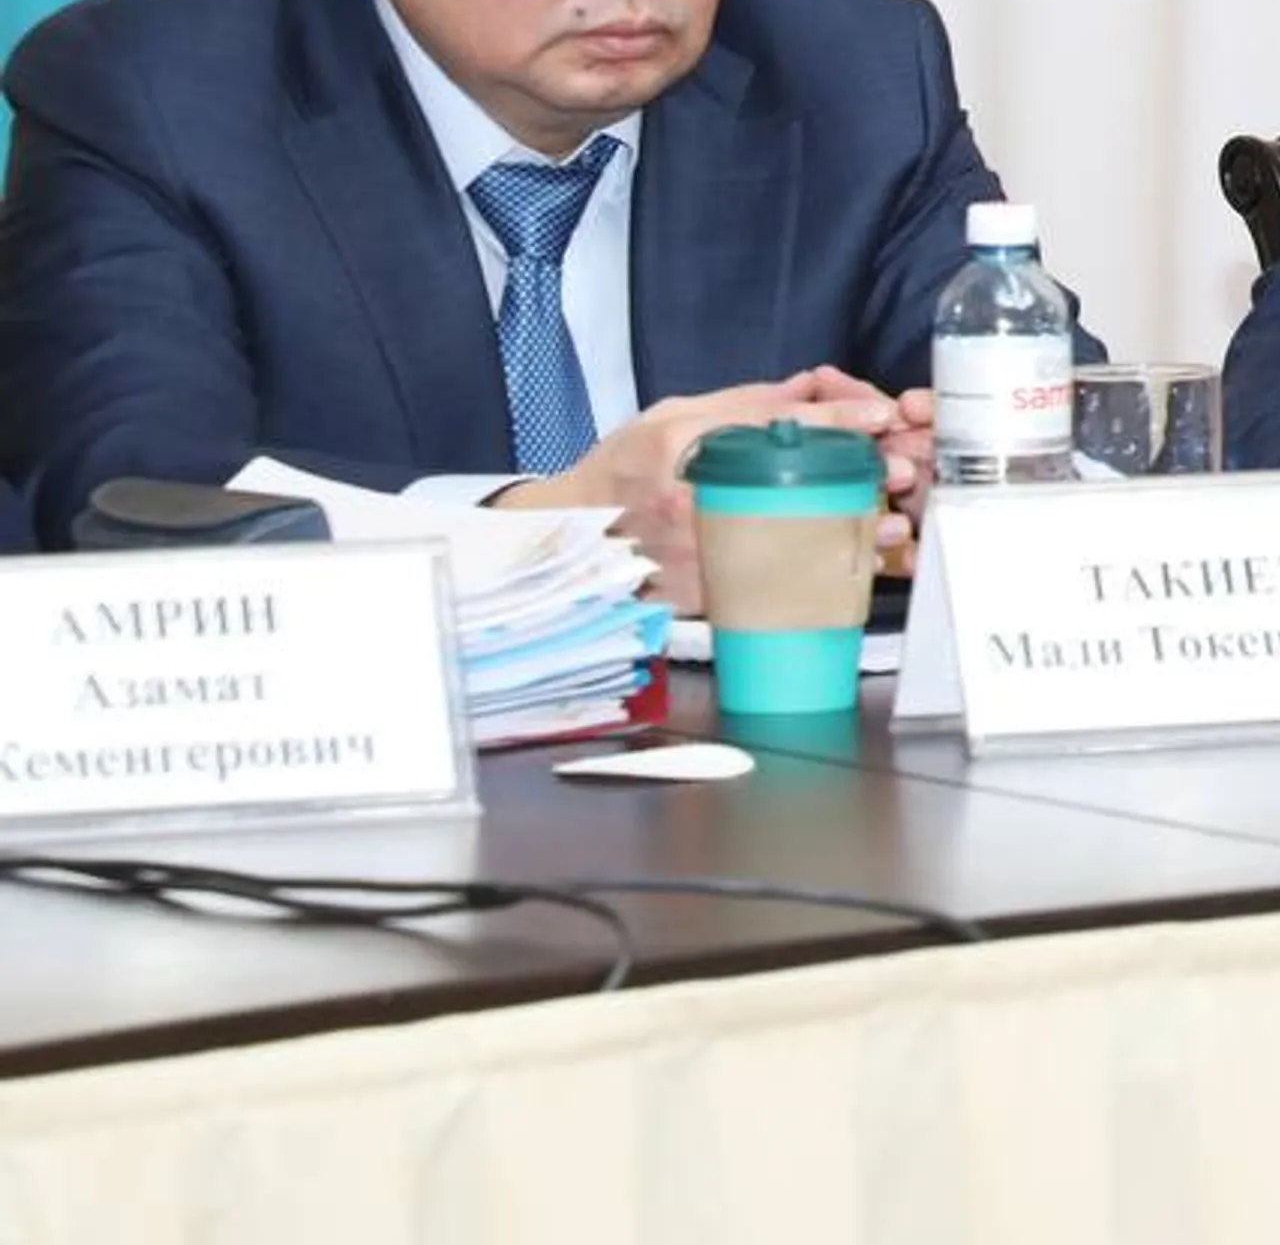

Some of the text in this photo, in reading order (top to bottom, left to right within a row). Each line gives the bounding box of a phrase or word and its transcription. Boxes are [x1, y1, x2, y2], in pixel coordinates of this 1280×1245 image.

[52, 593, 281, 645] АМРИН
[986, 630, 1125, 671] Мади
[73, 670, 270, 712] Азамат
